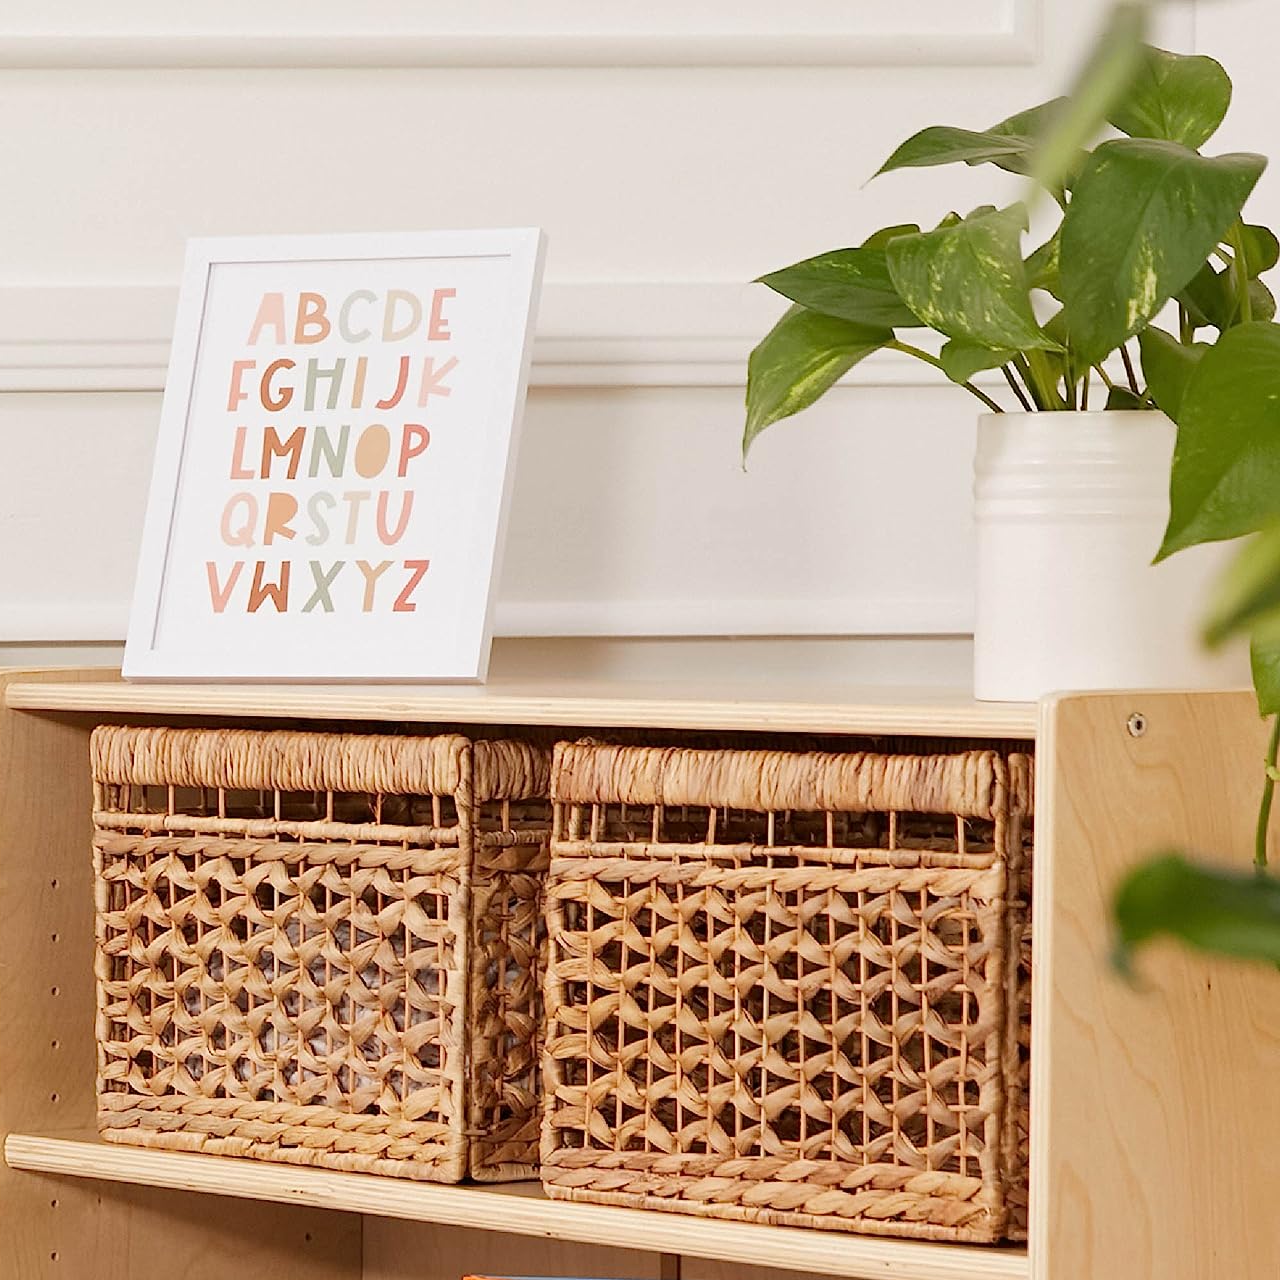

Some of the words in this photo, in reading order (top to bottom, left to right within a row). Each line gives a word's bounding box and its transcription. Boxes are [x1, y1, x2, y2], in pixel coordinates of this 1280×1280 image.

[246, 288, 457, 345] ABCDE
[226, 355, 460, 412] FGHIJK
[229, 423, 430, 480] LMNOP
[220, 490, 414, 549] QRSTU
[206, 560, 430, 613] VWXYZ
